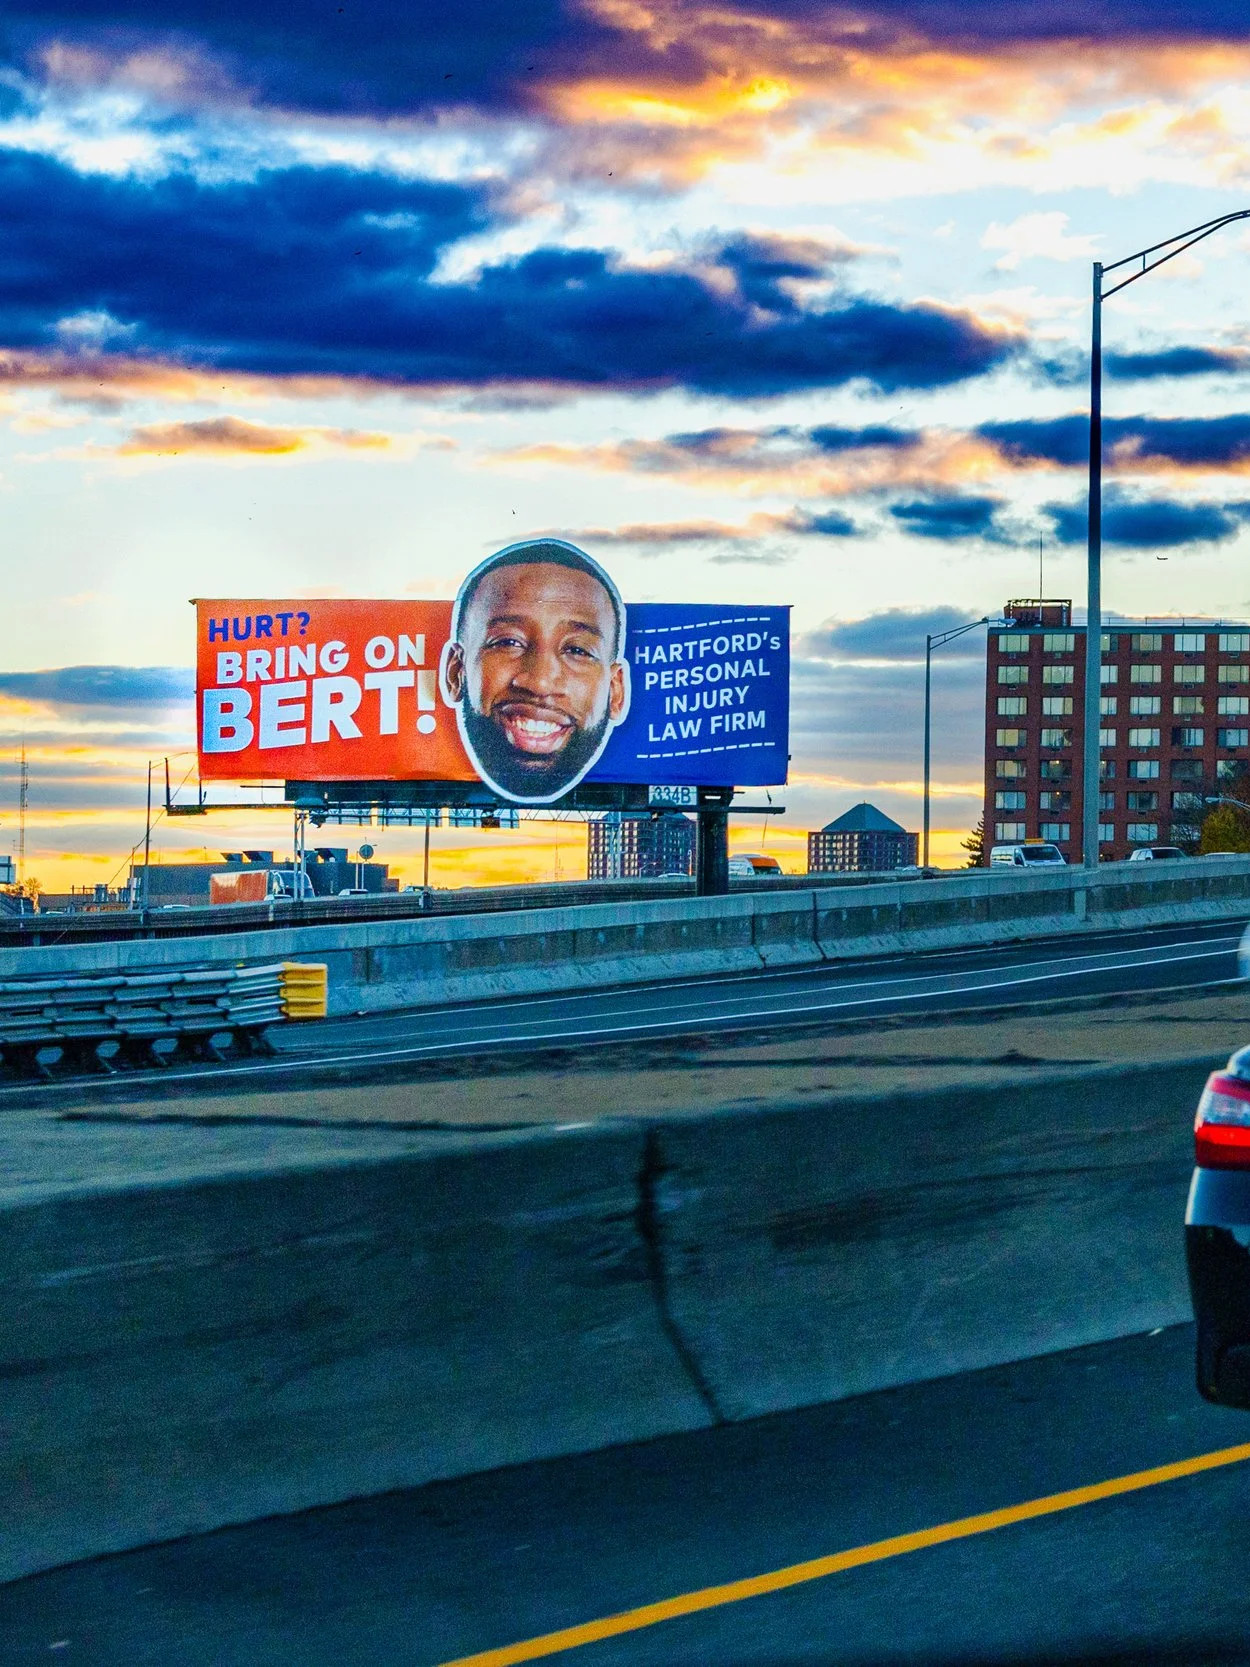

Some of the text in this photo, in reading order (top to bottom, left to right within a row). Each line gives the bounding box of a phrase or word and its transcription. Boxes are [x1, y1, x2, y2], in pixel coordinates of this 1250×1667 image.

[208, 611, 310, 643] HURT?
[216, 633, 426, 685] BRING ON
[634, 631, 781, 665] HARTFORD's
[644, 658, 771, 691] PERSONAL
[202, 669, 437, 754] BERT!
[665, 685, 749, 715] INJURY
[648, 710, 766, 742] LAW FIRM
[654, 786, 691, 803] 334B
